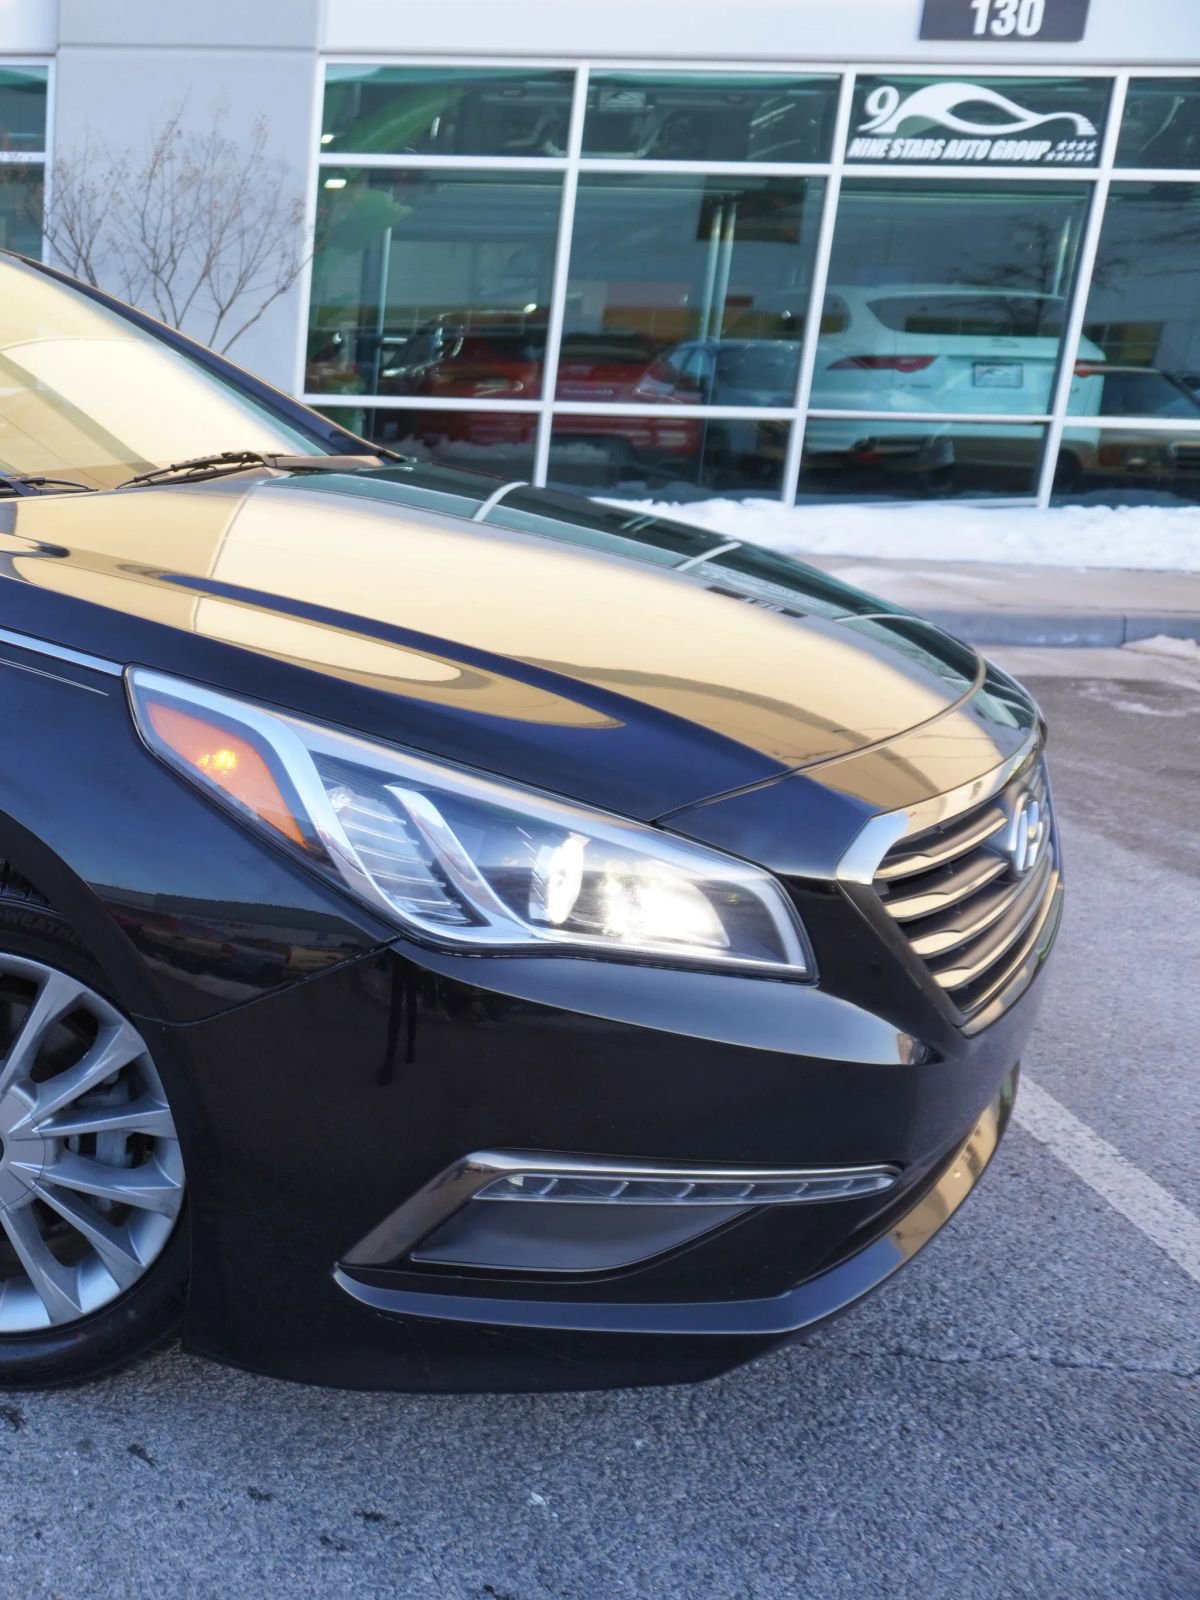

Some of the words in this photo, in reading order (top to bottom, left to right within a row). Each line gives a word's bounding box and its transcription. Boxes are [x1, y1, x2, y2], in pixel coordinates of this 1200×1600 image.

[970, 0, 1046, 37] 130
[857, 85, 900, 132] 9
[847, 137, 892, 159] NINE
[888, 138, 946, 160] STARS
[942, 139, 992, 161] AUTO
[988, 140, 1052, 162] GROUP
